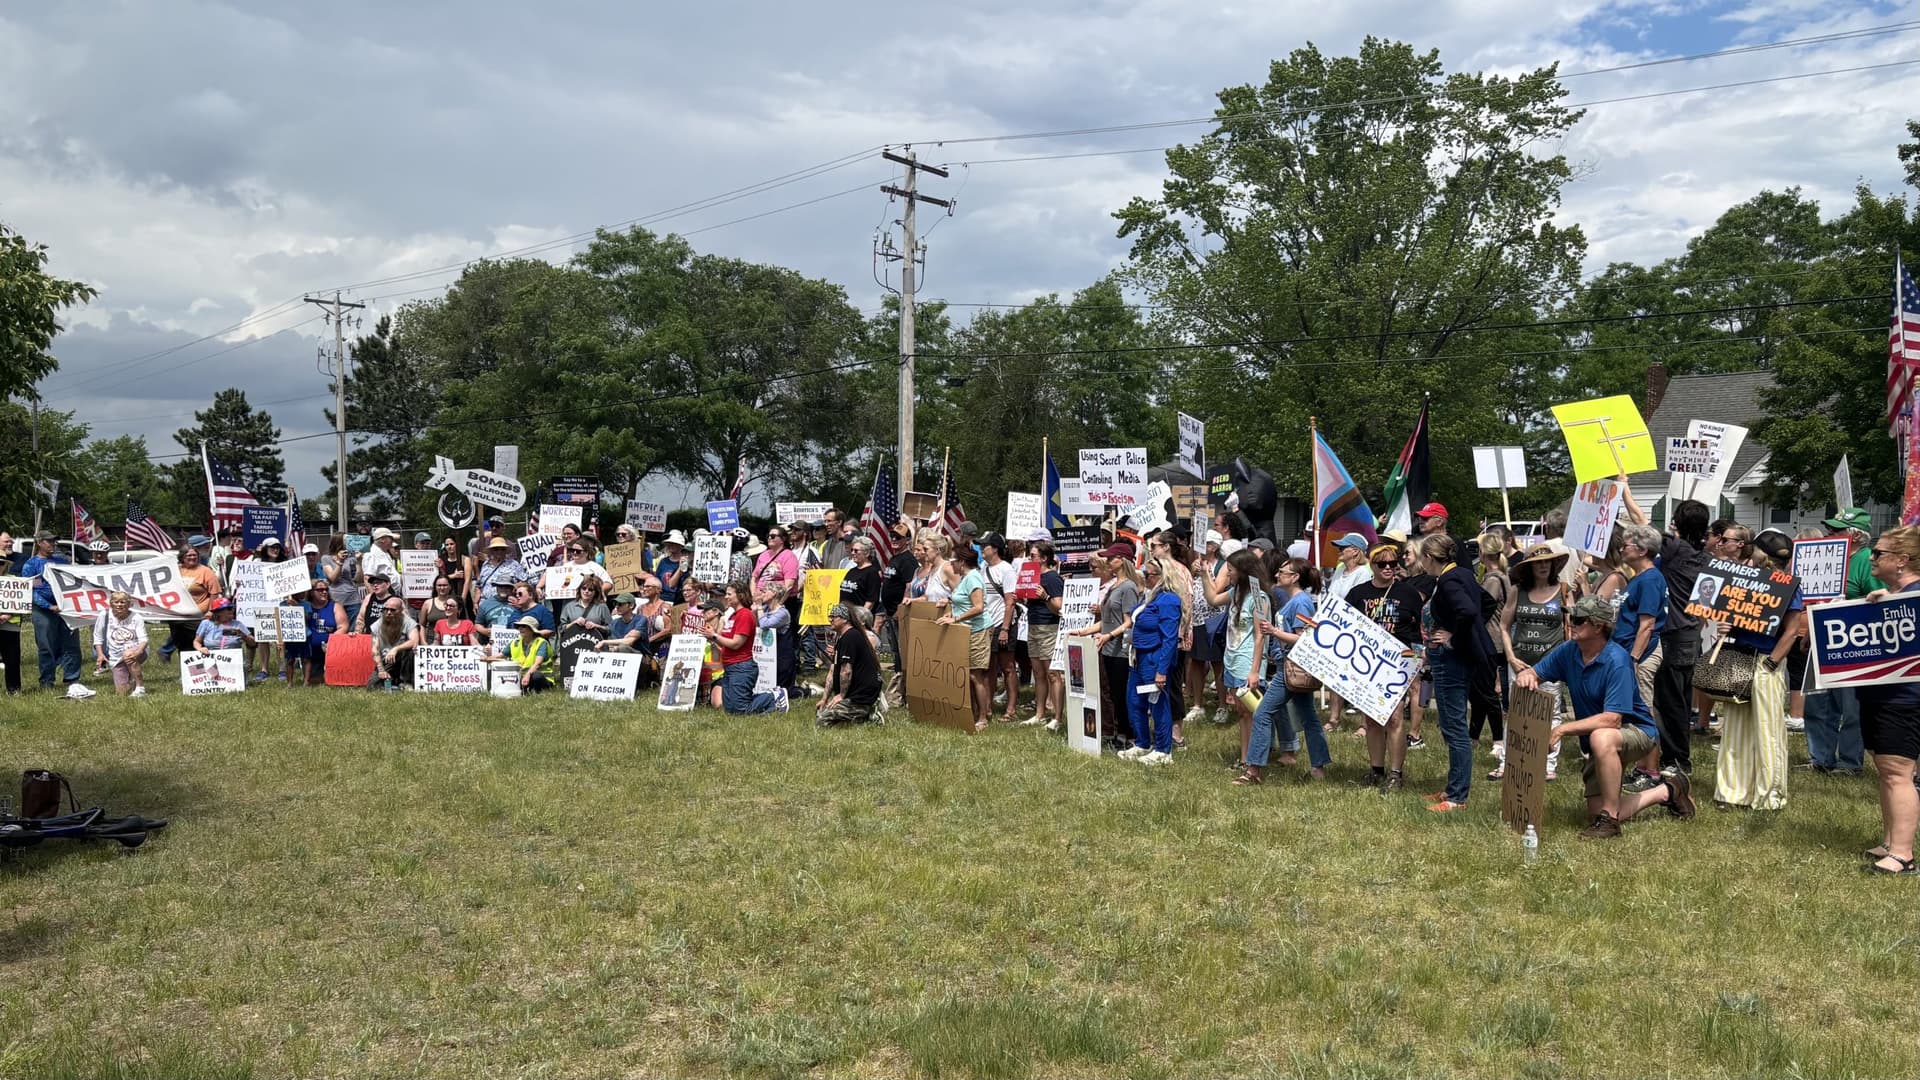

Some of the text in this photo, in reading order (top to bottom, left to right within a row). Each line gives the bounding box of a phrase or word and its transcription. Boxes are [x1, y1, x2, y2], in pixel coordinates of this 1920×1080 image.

[1673, 439, 1707, 448] HATE
[1081, 451, 1146, 466] Using Secret Police
[1669, 463, 1703, 473] GREAT
[434, 476, 446, 487] NO
[467, 471, 521, 493] BOMBS
[1118, 470, 1141, 484] Media
[466, 481, 519, 500] BALLROOMS
[473, 492, 517, 508] BULLSHIT
[1108, 491, 1135, 504] Fascism
[542, 506, 581, 517] WORKERS
[628, 502, 665, 512] AMERICA
[642, 514, 661, 524] great
[519, 535, 554, 553] EQUALI
[1797, 543, 1845, 560] SHAME
[269, 558, 306, 573] IMMIGRANTS
[526, 552, 548, 569] FOR
[237, 564, 263, 576] MAKE
[1708, 558, 1793, 585] FARMERS FOR
[1796, 560, 1843, 577] SHAME
[266, 572, 283, 582] MAKE
[274, 574, 306, 587] AMERICA
[240, 580, 264, 589] AMERI
[274, 584, 297, 595] GREAT
[1731, 577, 1771, 592] TRUMP
[550, 589, 577, 598] CHEET
[1065, 584, 1094, 599] TRUMP
[1720, 584, 1782, 609] ARE YOU
[237, 607, 255, 618] AGA
[1064, 603, 1092, 614] TARIFFS
[1322, 598, 1353, 629] How
[1684, 602, 1731, 622] ABOUT
[1726, 598, 1764, 618] SURE
[1883, 604, 1916, 622] Emily
[280, 609, 303, 621] Rights
[260, 620, 304, 631] Civil Rights
[1060, 617, 1094, 631] BANKRUPT
[257, 630, 305, 641] Human Rights
[495, 631, 520, 640] DEMOCRA
[561, 633, 600, 648] DEMOCRAC
[1353, 629, 1379, 651] much
[1823, 617, 1916, 654] Berge
[184, 653, 232, 665] WE LOVE OUR
[419, 647, 469, 659] PROTECT
[1382, 648, 1401, 662] will
[1827, 649, 1882, 660] FOR CONGRESS
[426, 658, 480, 674] Free Speech
[583, 655, 627, 667] DON'T BET
[1400, 660, 1409, 669] it
[192, 675, 208, 685] NOT
[426, 672, 480, 684] Due Process
[581, 670, 623, 680] THE FARM
[912, 636, 967, 711] Dozing
[190, 687, 227, 695] COUNTRY
[577, 684, 626, 695] ON FASCISM
[921, 688, 954, 723] Don
[1507, 762, 1534, 795] TRUMP
